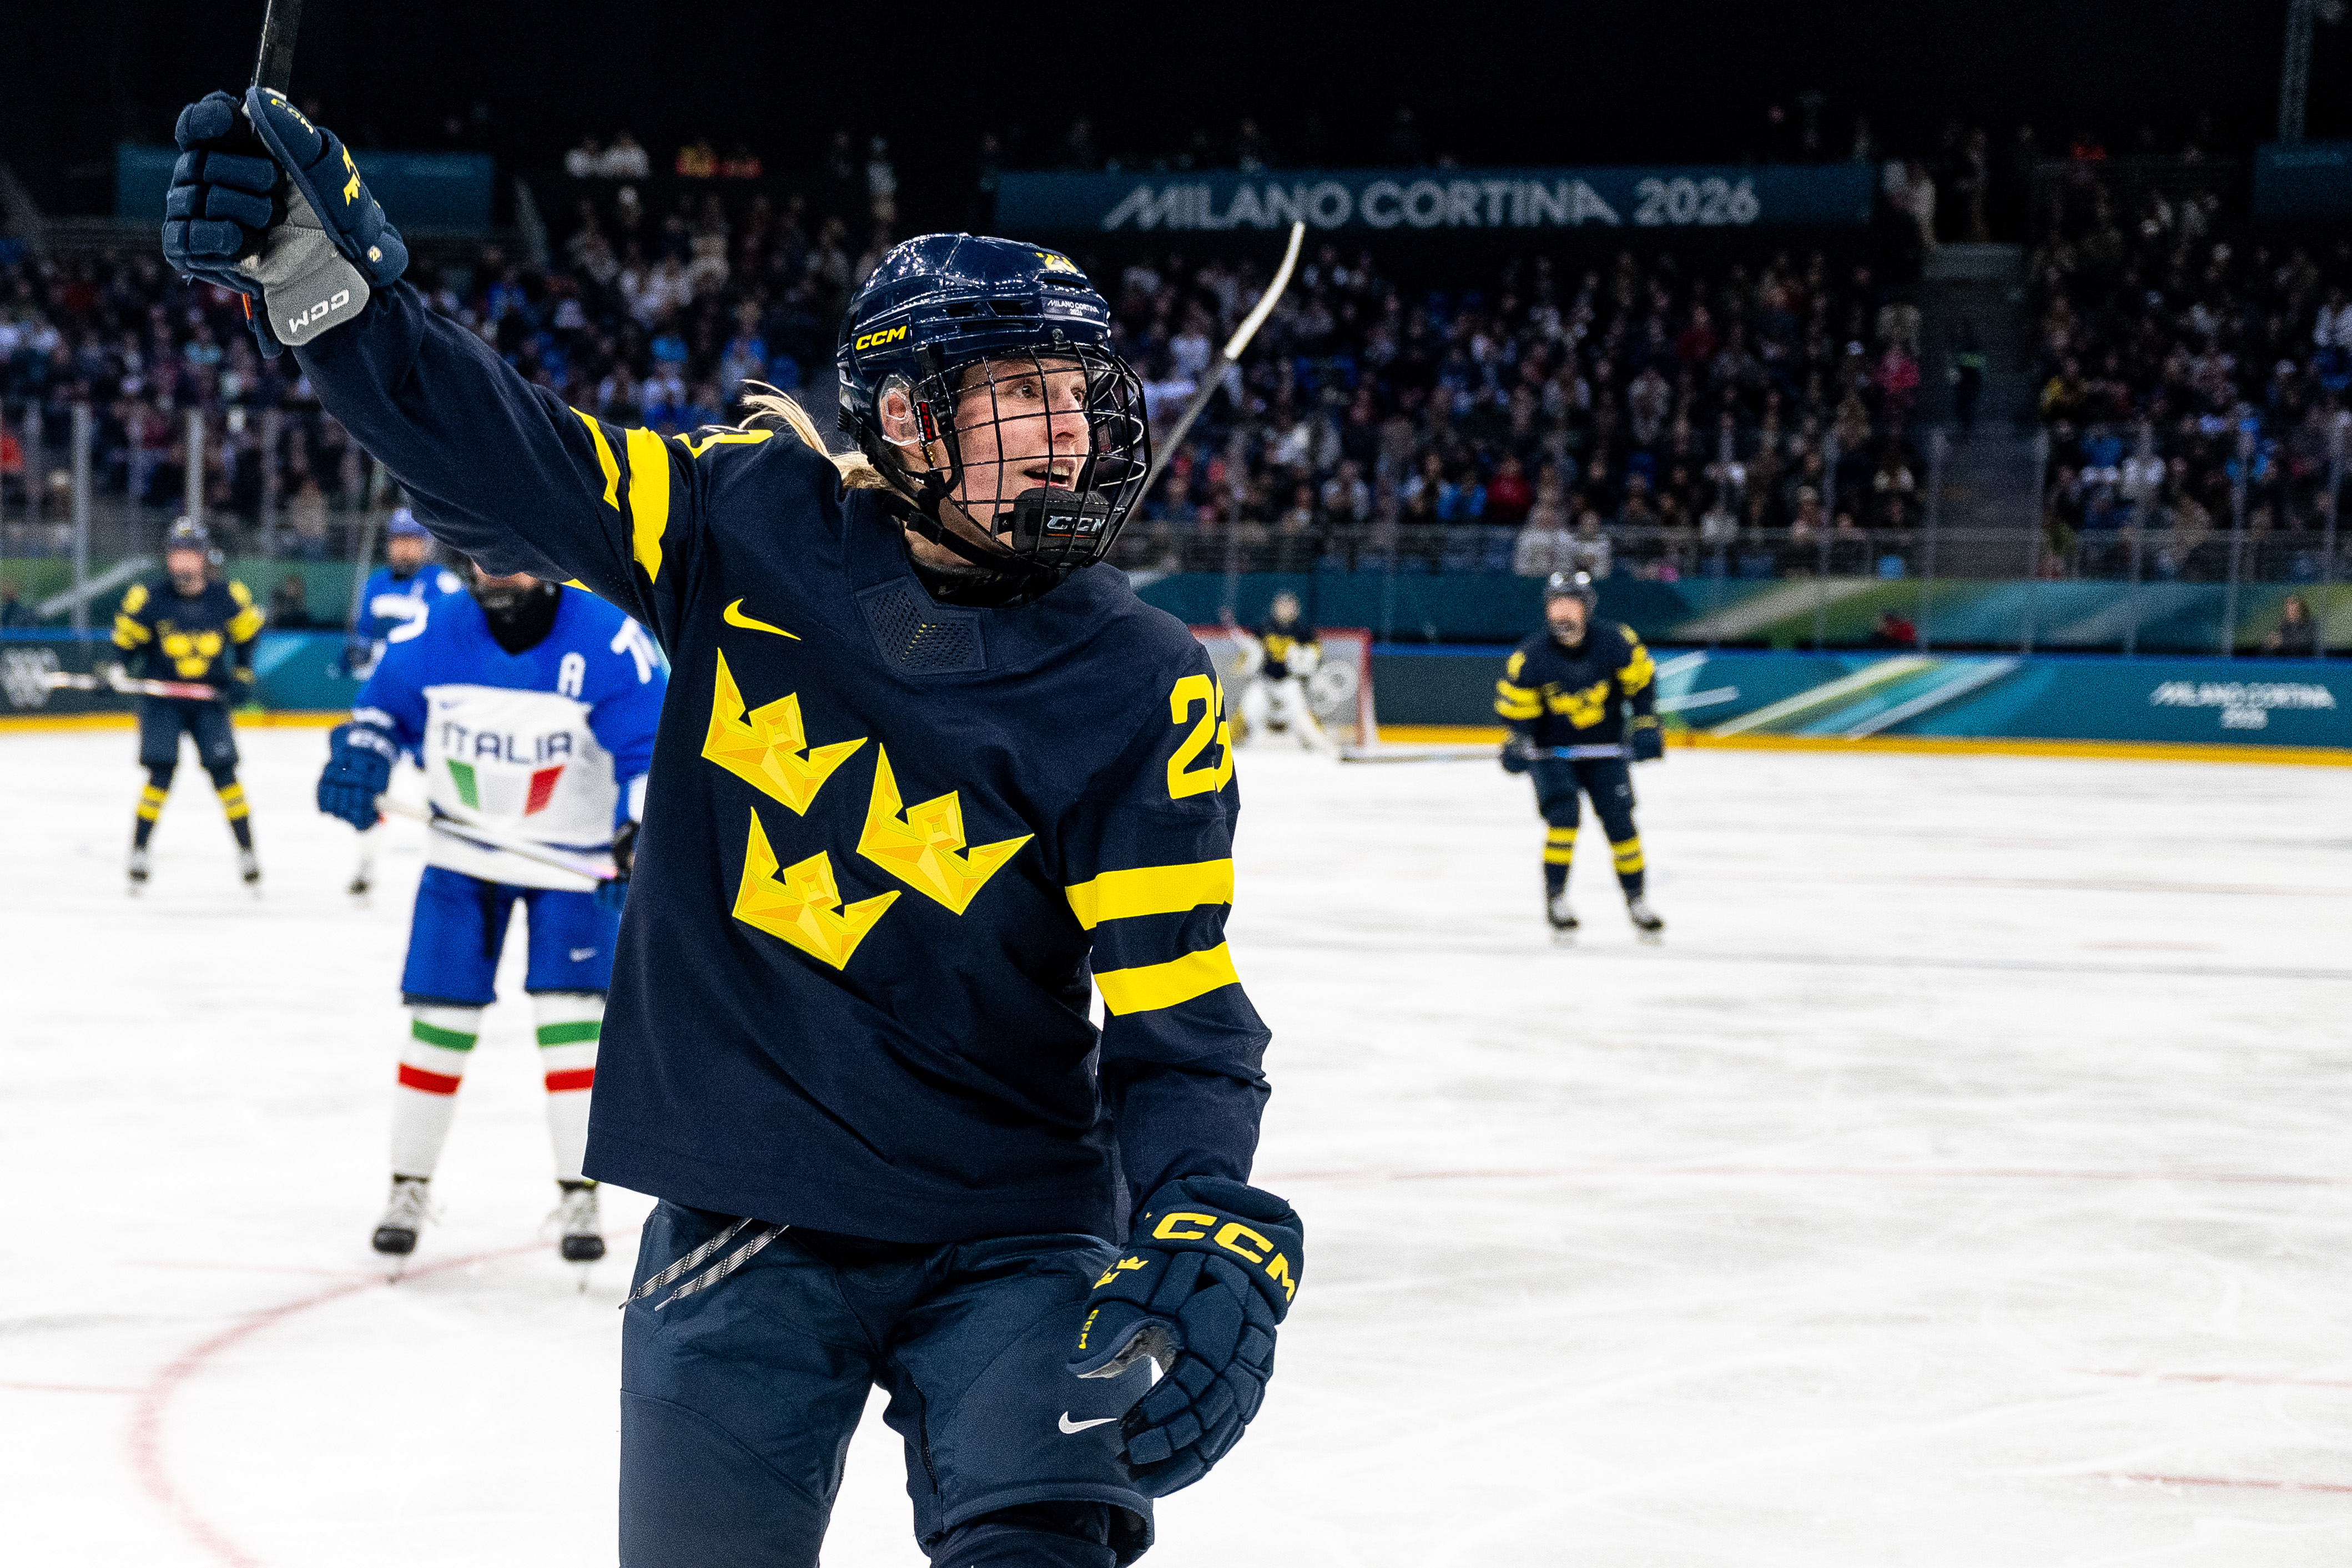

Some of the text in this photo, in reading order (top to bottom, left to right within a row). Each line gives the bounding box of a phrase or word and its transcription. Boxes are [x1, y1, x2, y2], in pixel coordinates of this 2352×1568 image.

[1102, 177, 1760, 230] MILANO CORTINA 2026
[289, 289, 349, 333] CCM
[1047, 299, 1100, 314] MILANO CORTINA
[855, 325, 907, 350] CCM
[558, 652, 585, 697] A
[442, 720, 573, 765] ITALIA
[1152, 1212, 1296, 1302] CCM
